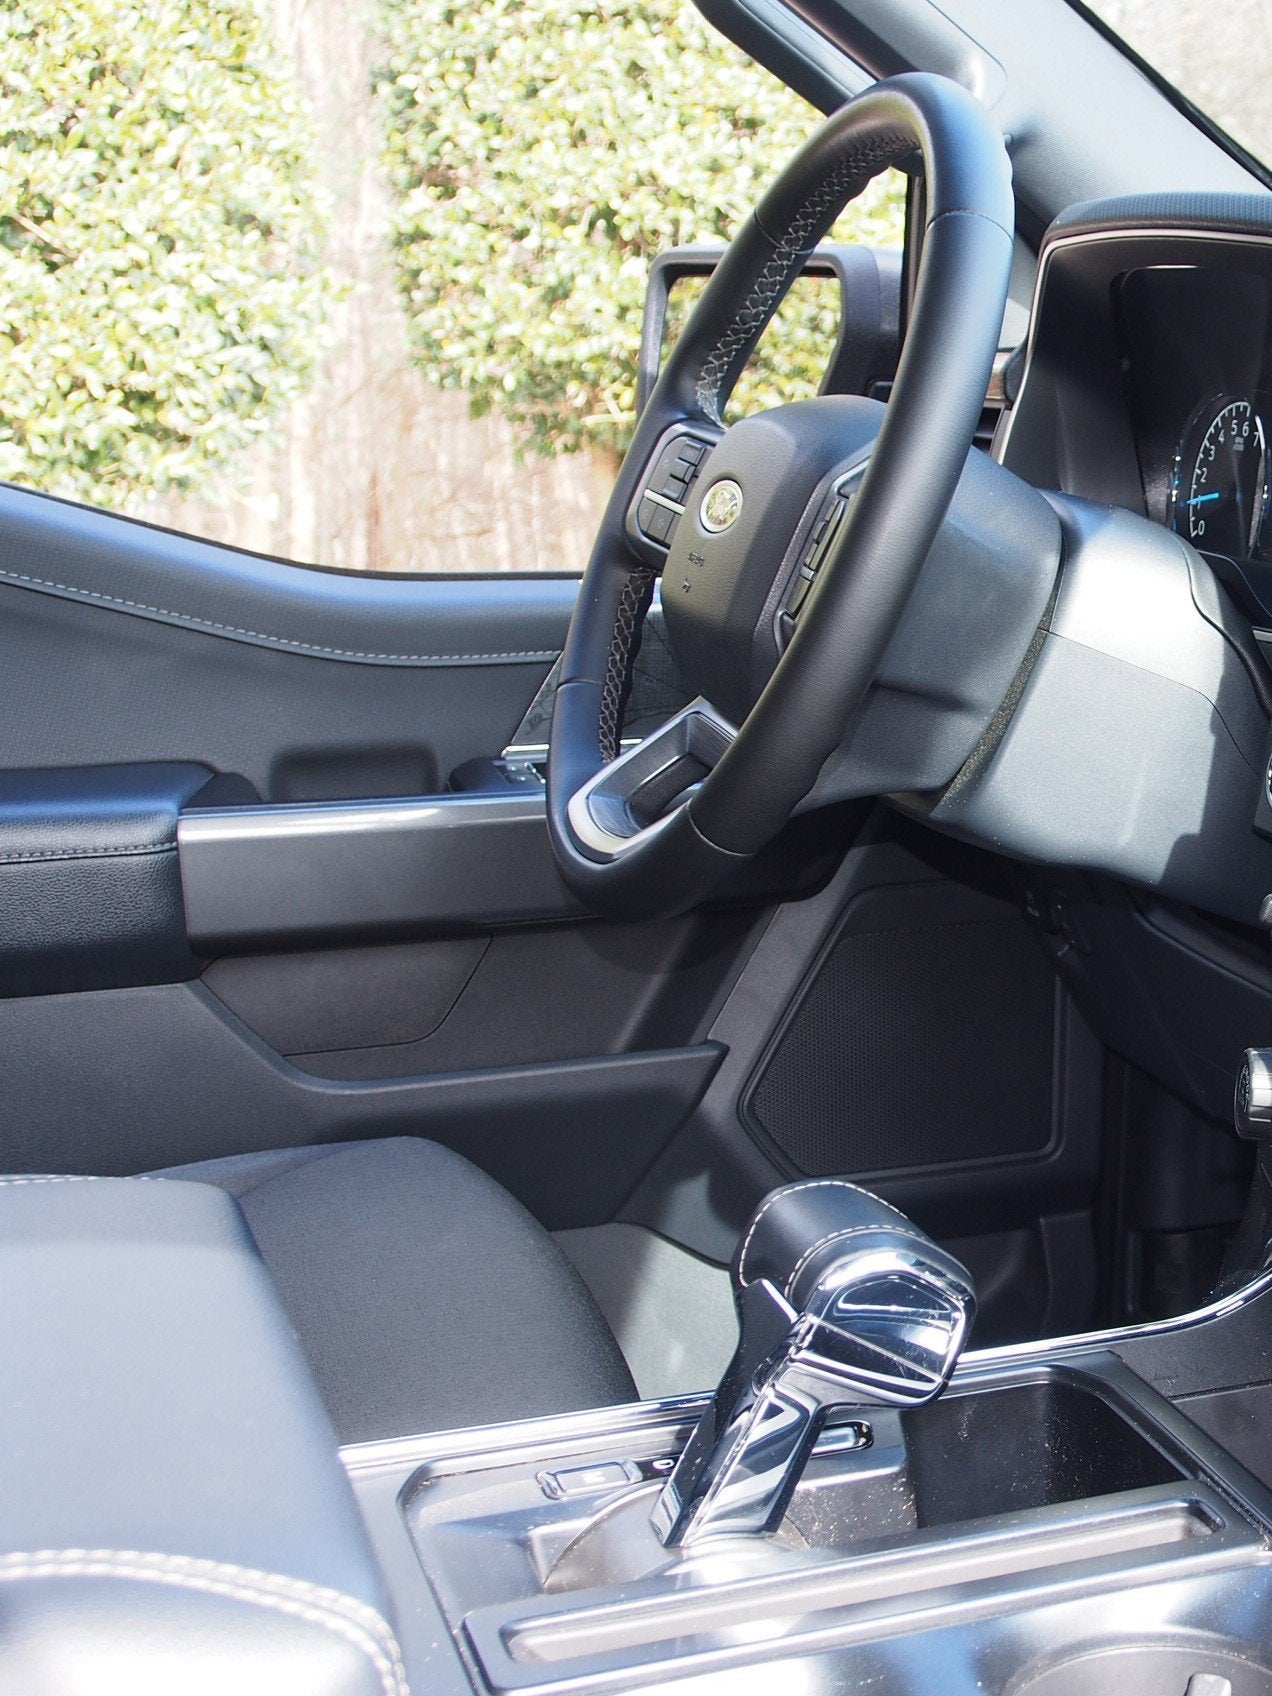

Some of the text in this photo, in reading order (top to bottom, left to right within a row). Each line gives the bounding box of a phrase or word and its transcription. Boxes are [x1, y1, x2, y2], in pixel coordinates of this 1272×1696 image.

[1230, 419, 1237, 436] 5
[1242, 421, 1249, 437] 6
[1218, 429, 1225, 444] 4
[1253, 431, 1260, 447] 7
[1208, 445, 1216, 461] 3
[1200, 467, 1208, 483] 2
[1197, 519, 1206, 536] 0
